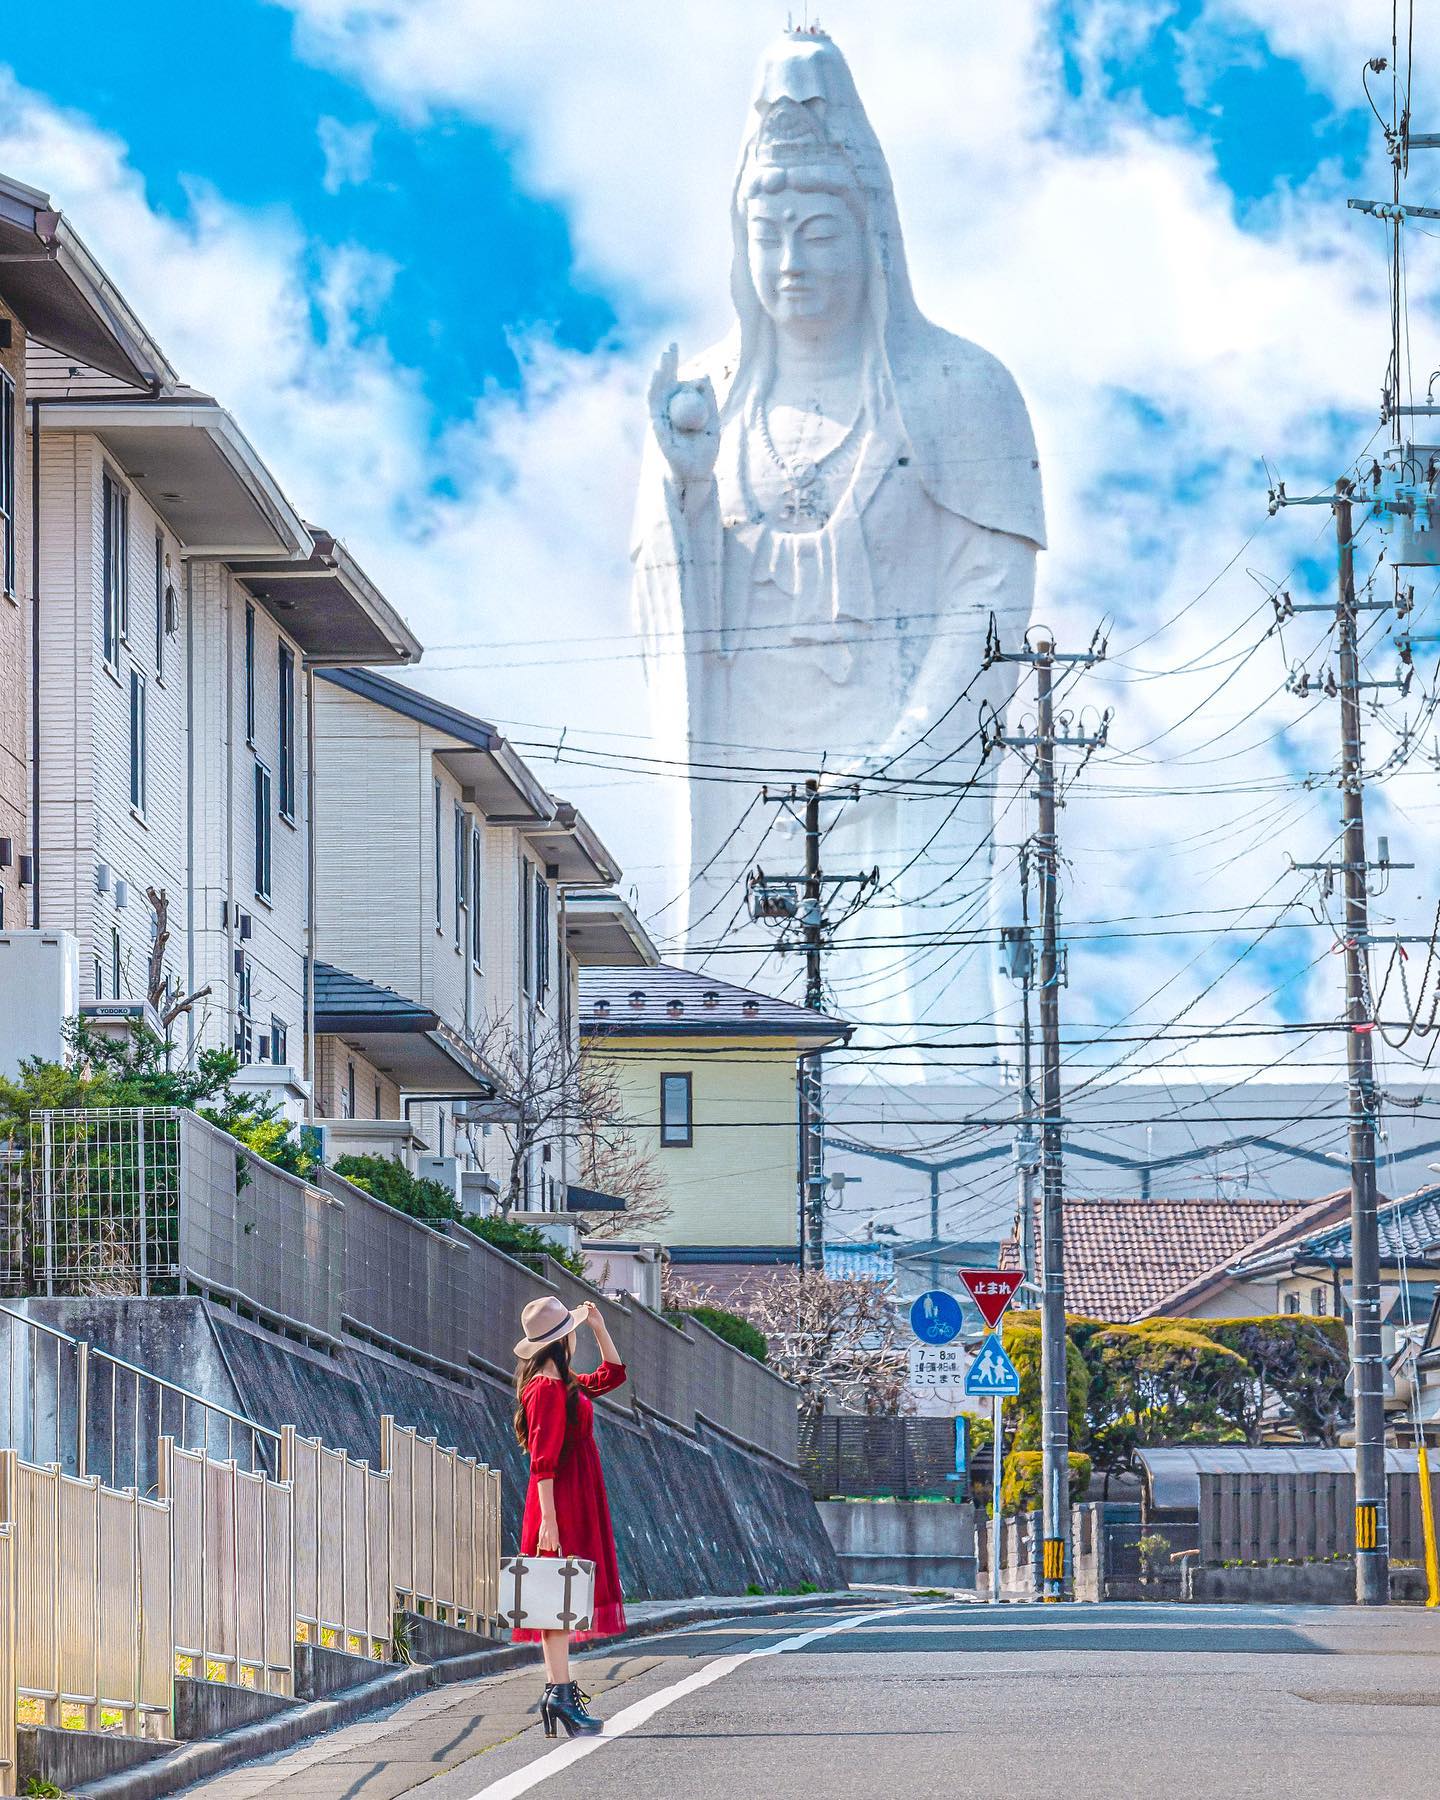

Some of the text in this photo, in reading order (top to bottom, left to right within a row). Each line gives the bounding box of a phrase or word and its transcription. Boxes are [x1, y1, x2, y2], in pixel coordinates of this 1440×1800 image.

[973, 1281, 1012, 1295] 止まれ
[915, 1374, 961, 1384] ここまで
